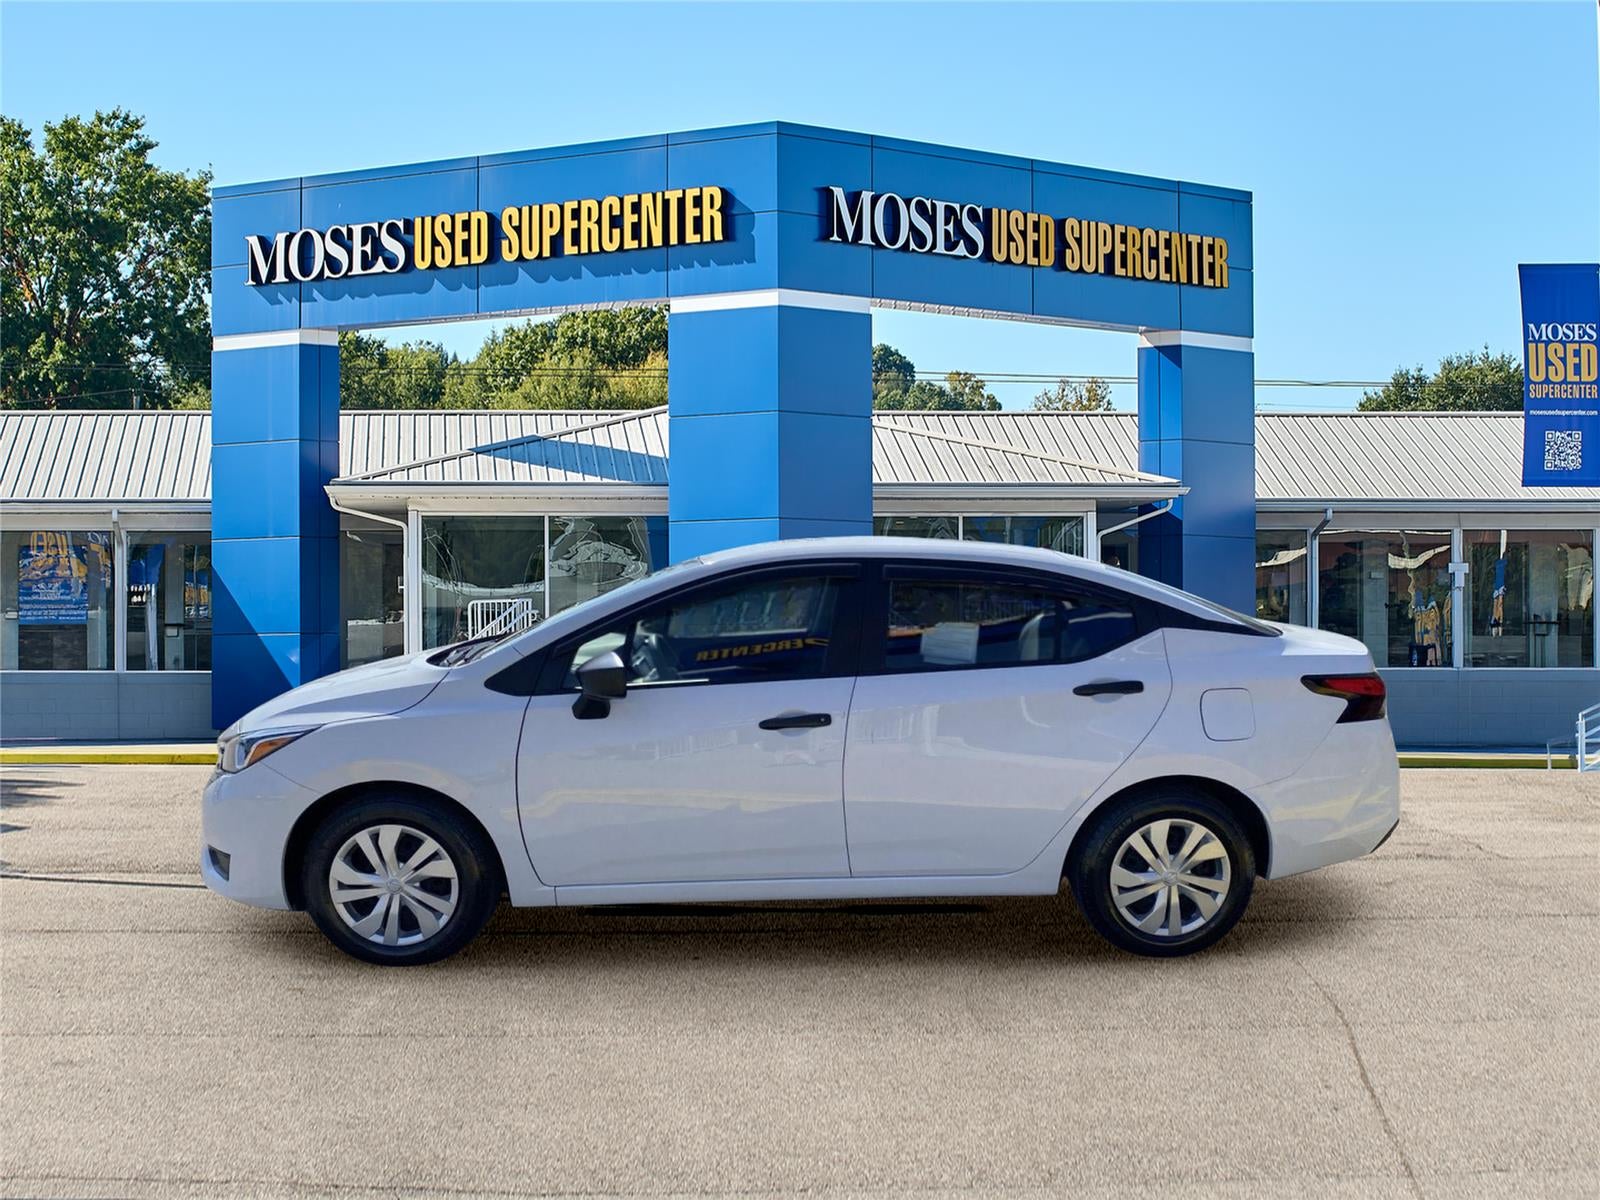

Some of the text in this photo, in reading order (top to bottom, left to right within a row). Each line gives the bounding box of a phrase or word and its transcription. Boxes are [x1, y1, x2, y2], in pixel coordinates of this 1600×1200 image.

[244, 185, 723, 286] MOSES USED SUPERCENTER
[828, 186, 1229, 288] MOSES USED SUPERCENTER
[1528, 323, 1597, 341] MOSES
[1528, 343, 1598, 382] USED
[1529, 384, 1598, 399] SUPERCENTER
